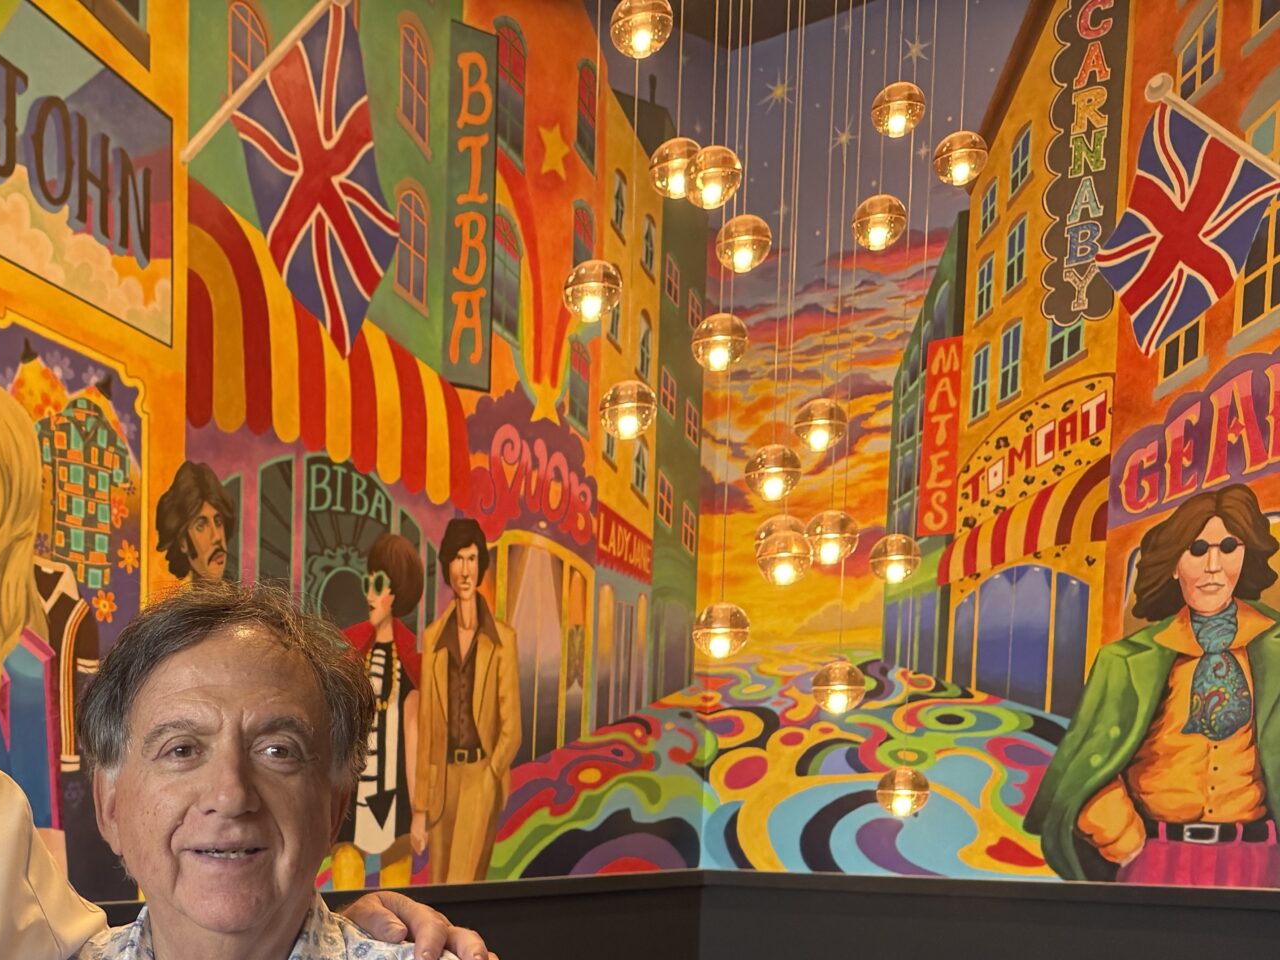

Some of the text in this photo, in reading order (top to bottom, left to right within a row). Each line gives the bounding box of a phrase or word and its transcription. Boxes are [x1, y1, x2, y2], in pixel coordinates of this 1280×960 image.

[449, 51, 493, 365] BIBA
[1063, 0, 1114, 311] CARNABY
[309, 464, 387, 524] BIBA
[470, 423, 593, 545] SNOB
[924, 345, 959, 531] MATES
[963, 391, 1108, 503] TOMCAT
[1119, 363, 1280, 514] GEA
